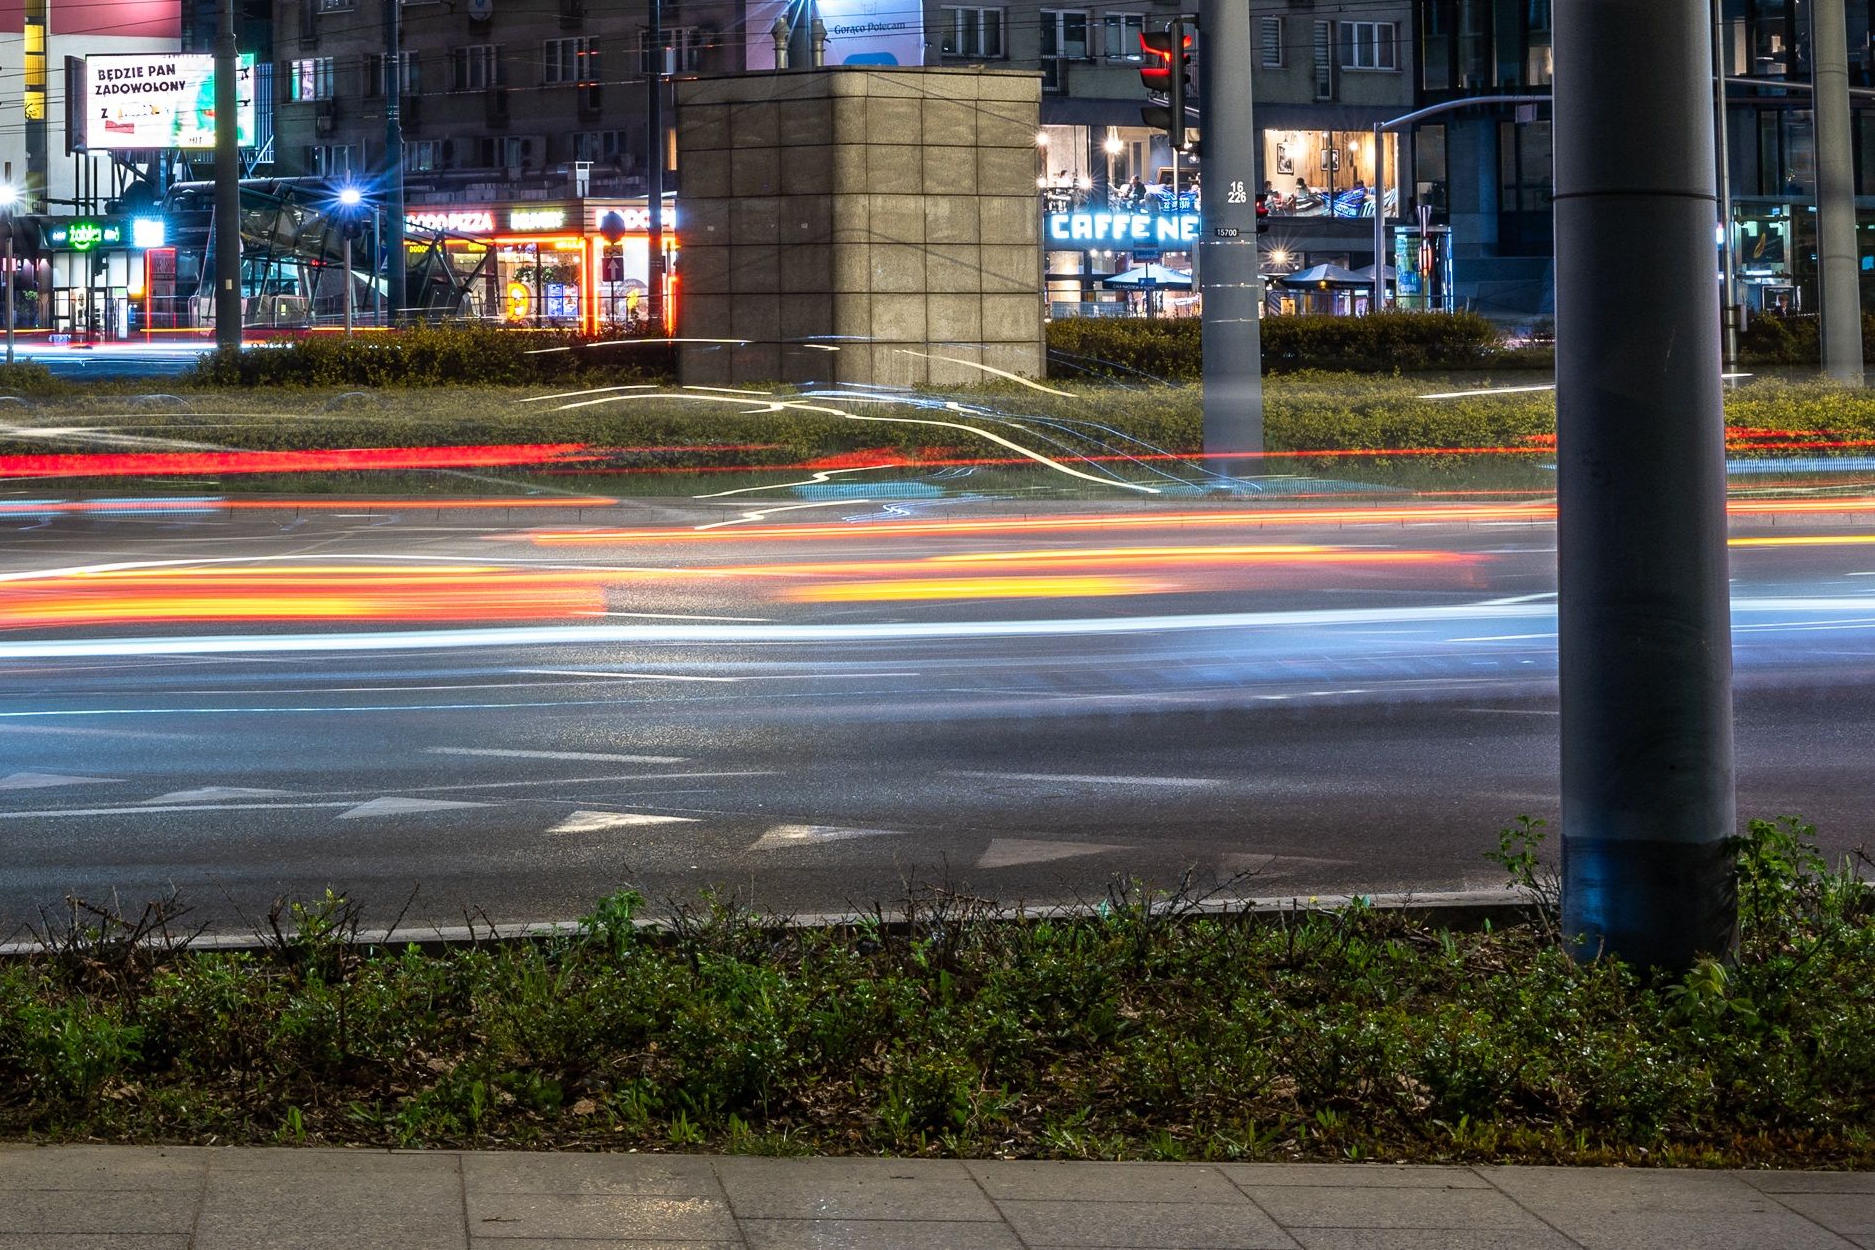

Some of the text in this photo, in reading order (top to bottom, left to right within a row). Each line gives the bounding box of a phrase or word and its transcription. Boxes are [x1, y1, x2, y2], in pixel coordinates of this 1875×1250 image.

[834, 22, 906, 35] Gorąco Polecam
[98, 64, 176, 82] BĘDZIE PAN
[101, 108, 108, 119] Z
[1230, 181, 1244, 192] 16
[1227, 192, 1247, 203] 226
[448, 212, 494, 232] PIZZA
[1157, 215, 1200, 240] NE
[1216, 229, 1237, 237] 15700
